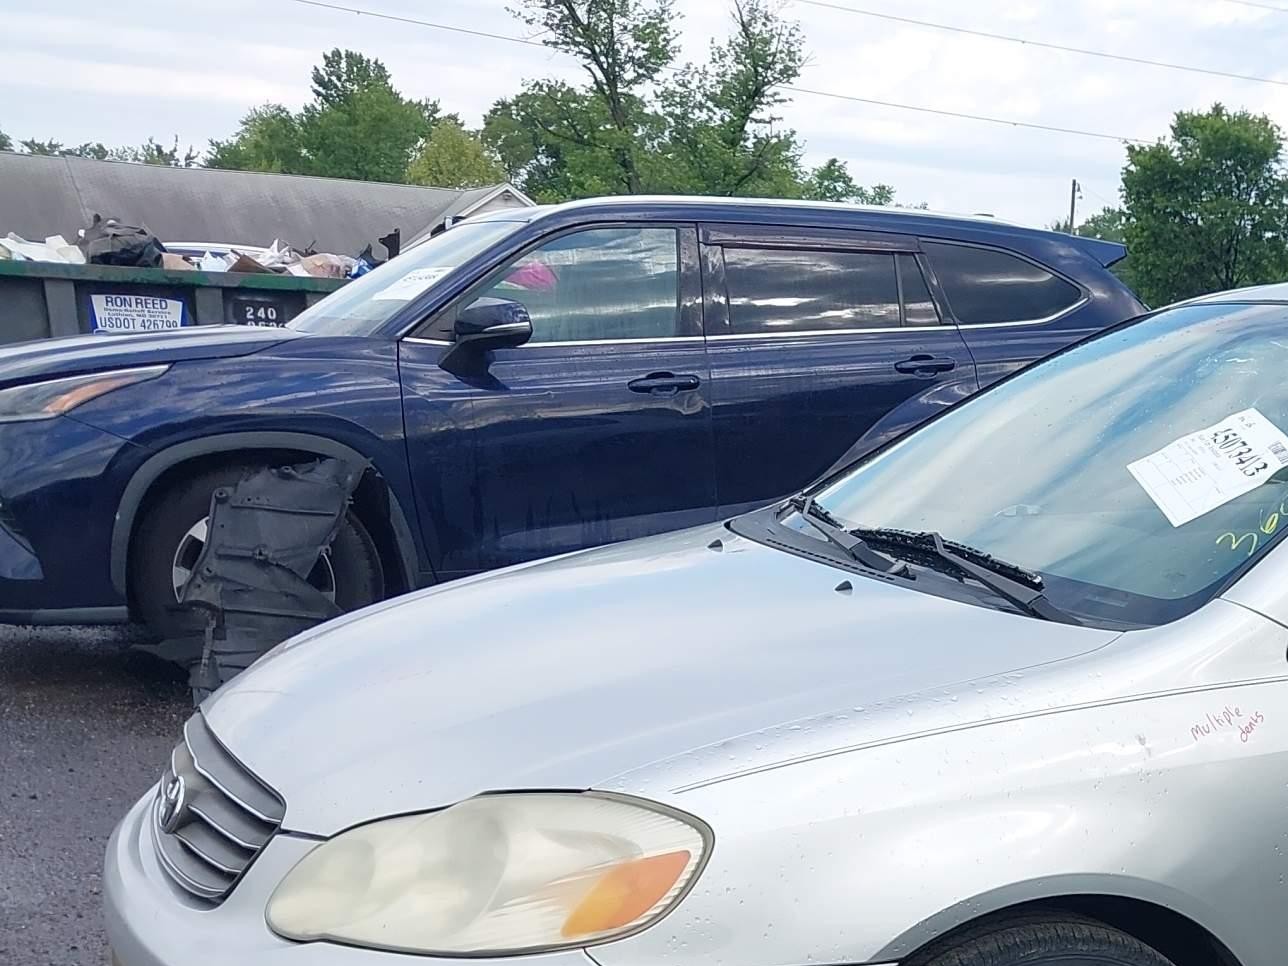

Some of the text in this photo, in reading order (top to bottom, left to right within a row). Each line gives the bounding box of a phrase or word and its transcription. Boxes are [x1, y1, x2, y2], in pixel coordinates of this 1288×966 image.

[105, 296, 168, 309] RON REED
[246, 306, 277, 320] 240
[100, 317, 136, 329] USDOT
[1211, 428, 1268, 476] 45073413
[1238, 711, 1264, 743] dents
